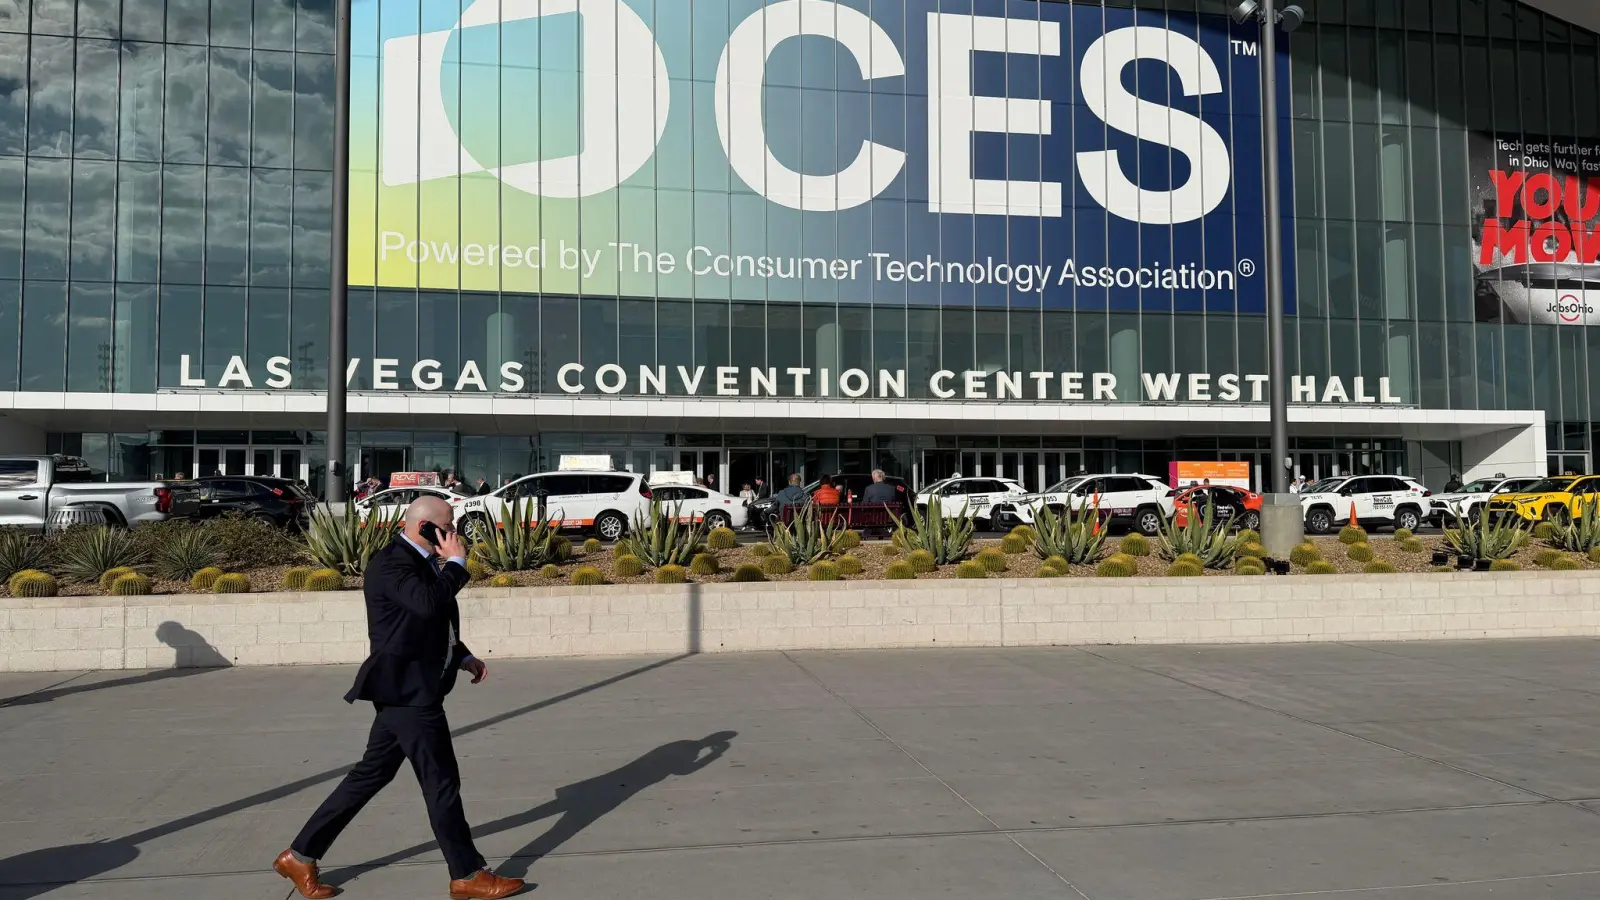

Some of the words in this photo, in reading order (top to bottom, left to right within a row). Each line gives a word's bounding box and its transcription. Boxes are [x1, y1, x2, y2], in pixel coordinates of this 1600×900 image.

[714, 0, 1231, 225] CES
[1496, 138, 1522, 151] Tech
[1525, 142, 1550, 155] gets
[1553, 142, 1592, 156] further
[1508, 154, 1519, 167] in
[1554, 157, 1577, 173] Way
[1488, 169, 1600, 223] YOU
[380, 230, 546, 269] Powered
[559, 239, 602, 279] by
[608, 241, 676, 274] The
[686, 245, 862, 281] Consumer
[868, 252, 1052, 293] Technology
[1546, 302, 1594, 314] JobsOhio
[180, 354, 293, 389] LAS
[556, 361, 906, 398] CONVENTION
[929, 369, 1118, 401] CENTER
[1142, 372, 1269, 402] WEST
[1291, 374, 1401, 404] HALL
[464, 499, 481, 508] 4398
